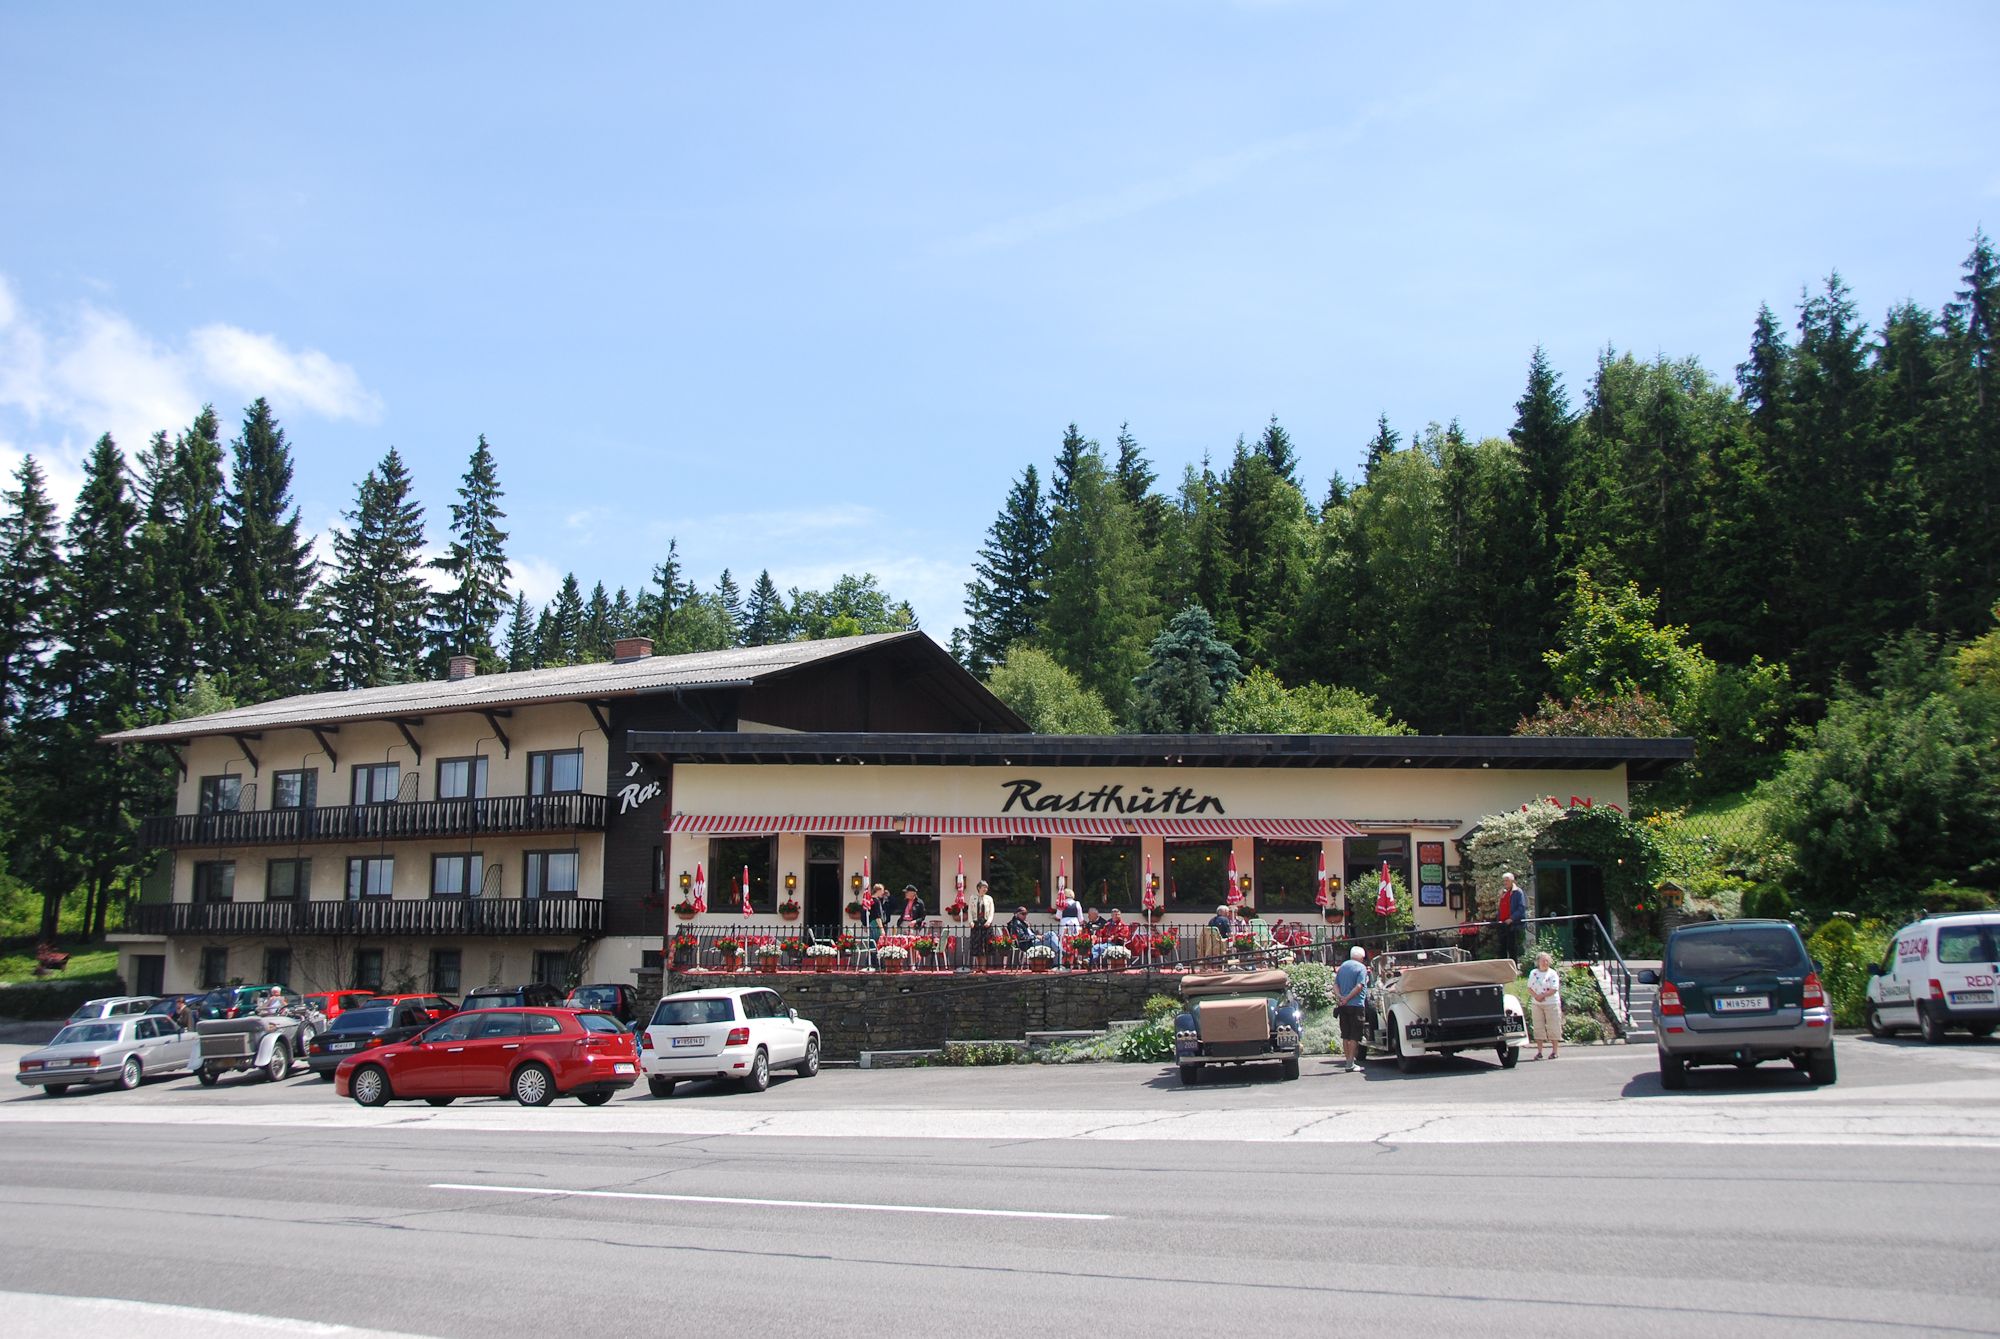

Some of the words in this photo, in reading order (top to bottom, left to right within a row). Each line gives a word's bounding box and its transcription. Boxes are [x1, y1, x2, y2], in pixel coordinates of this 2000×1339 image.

[1965, 975, 1994, 987] RED
[1410, 1028, 1422, 1037] GB
[1502, 1024, 1523, 1033] 1078
